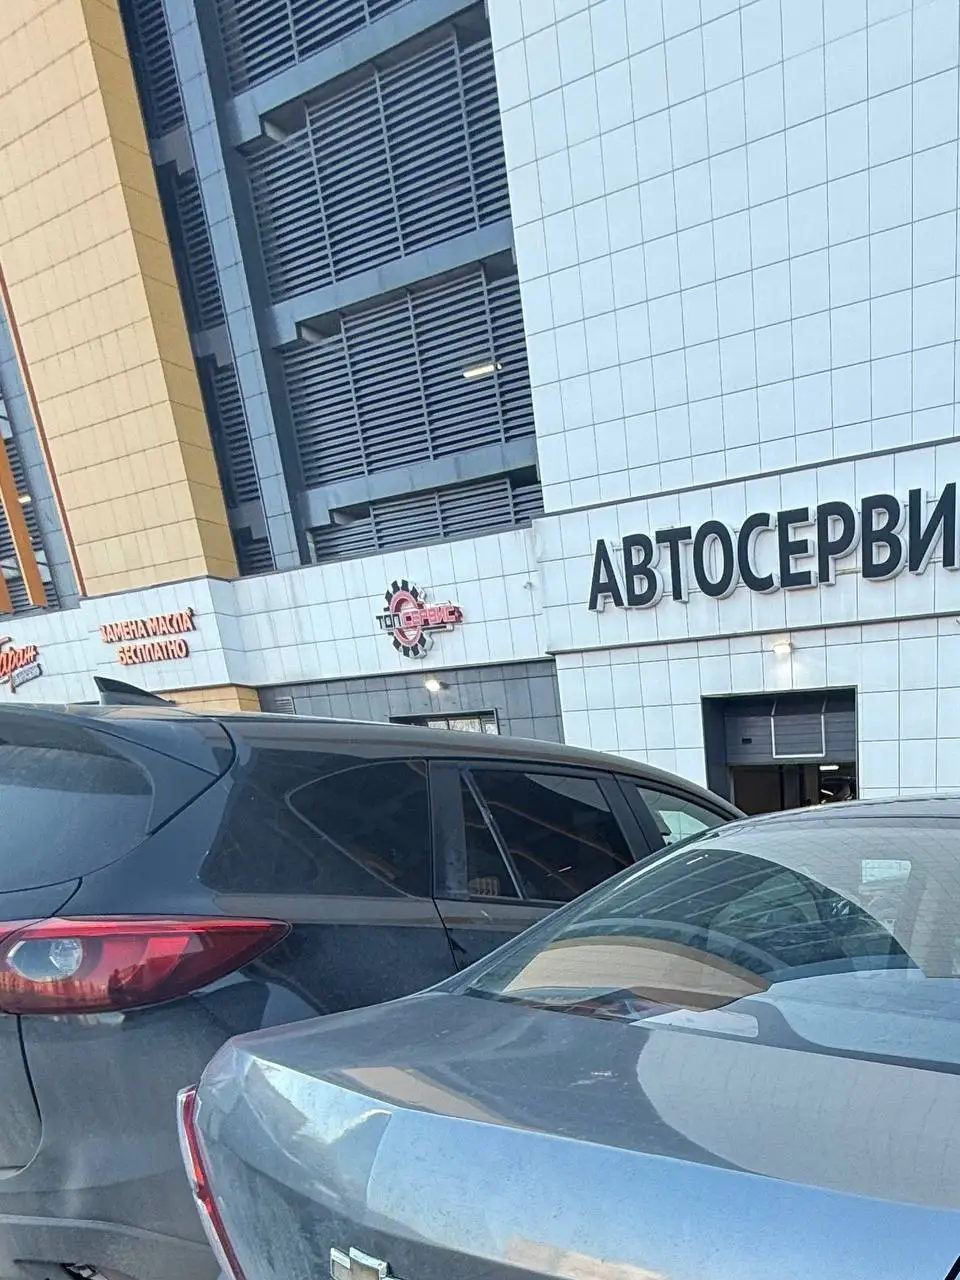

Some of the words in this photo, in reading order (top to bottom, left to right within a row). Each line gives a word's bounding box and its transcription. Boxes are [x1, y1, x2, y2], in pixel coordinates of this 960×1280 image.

[376, 613, 401, 629] ТОП
[402, 605, 459, 627] СЕРВИС
[100, 619, 149, 643] ЗАМЕНА
[119, 639, 189, 664] БЕСПЛАТНО
